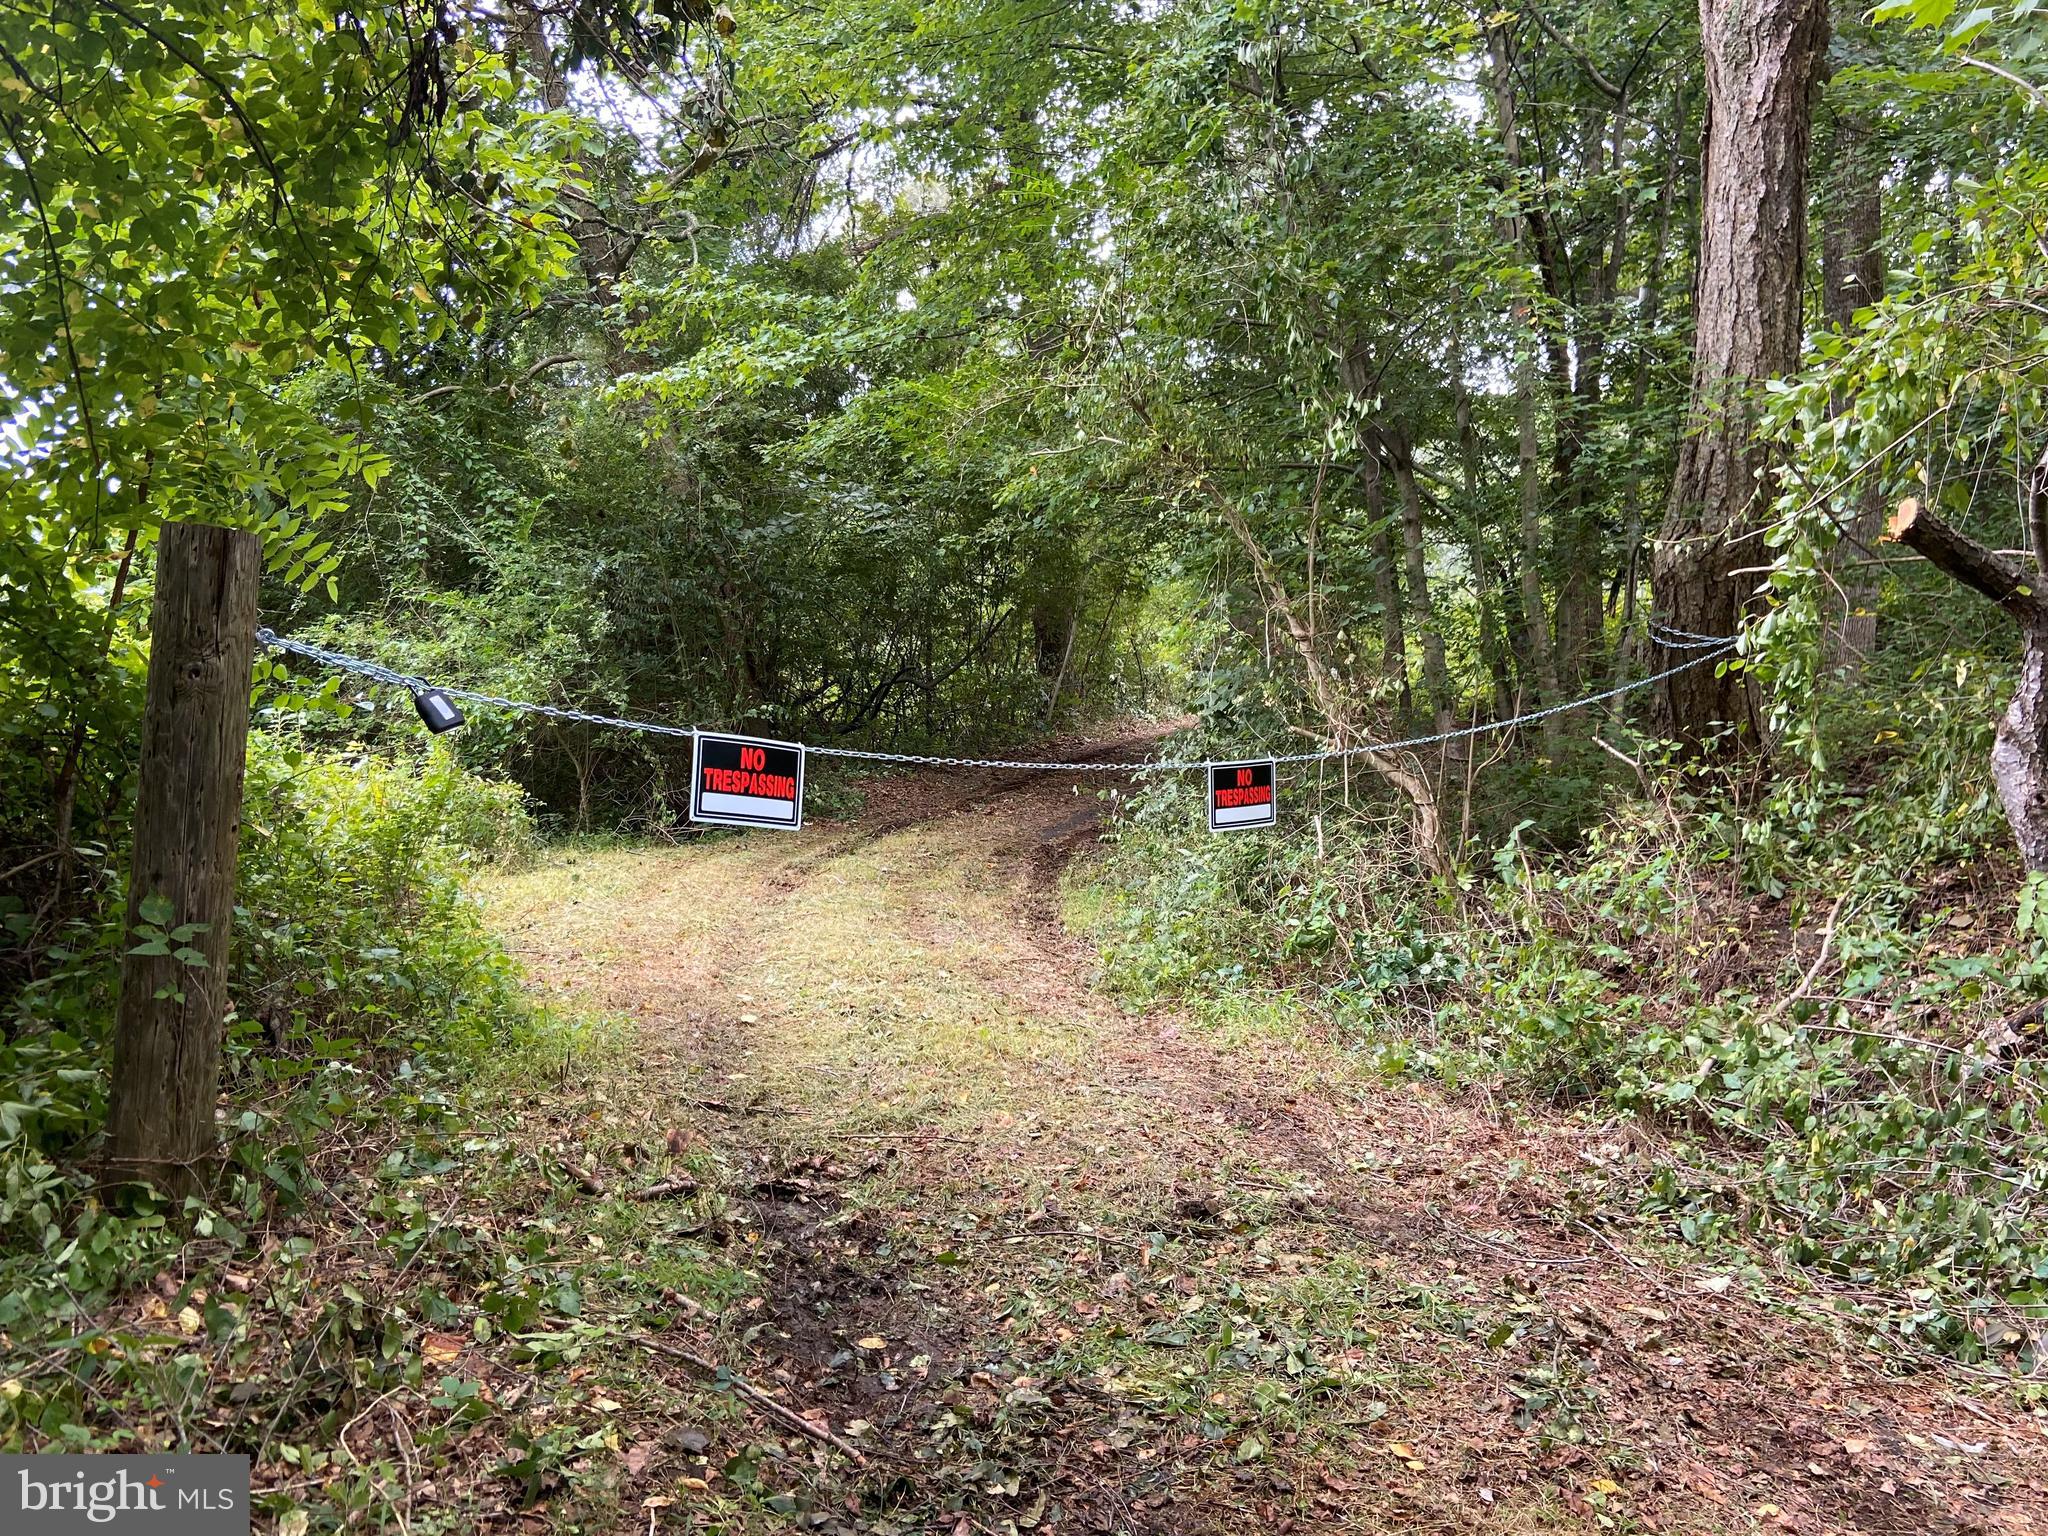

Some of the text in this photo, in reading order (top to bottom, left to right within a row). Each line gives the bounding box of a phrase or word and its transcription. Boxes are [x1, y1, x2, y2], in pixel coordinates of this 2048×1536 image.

[740, 747, 766, 772] NO
[703, 767, 795, 800] TRESPASSING
[1237, 768, 1253, 786] NO
[1215, 785, 1272, 807] TRESPASSING
